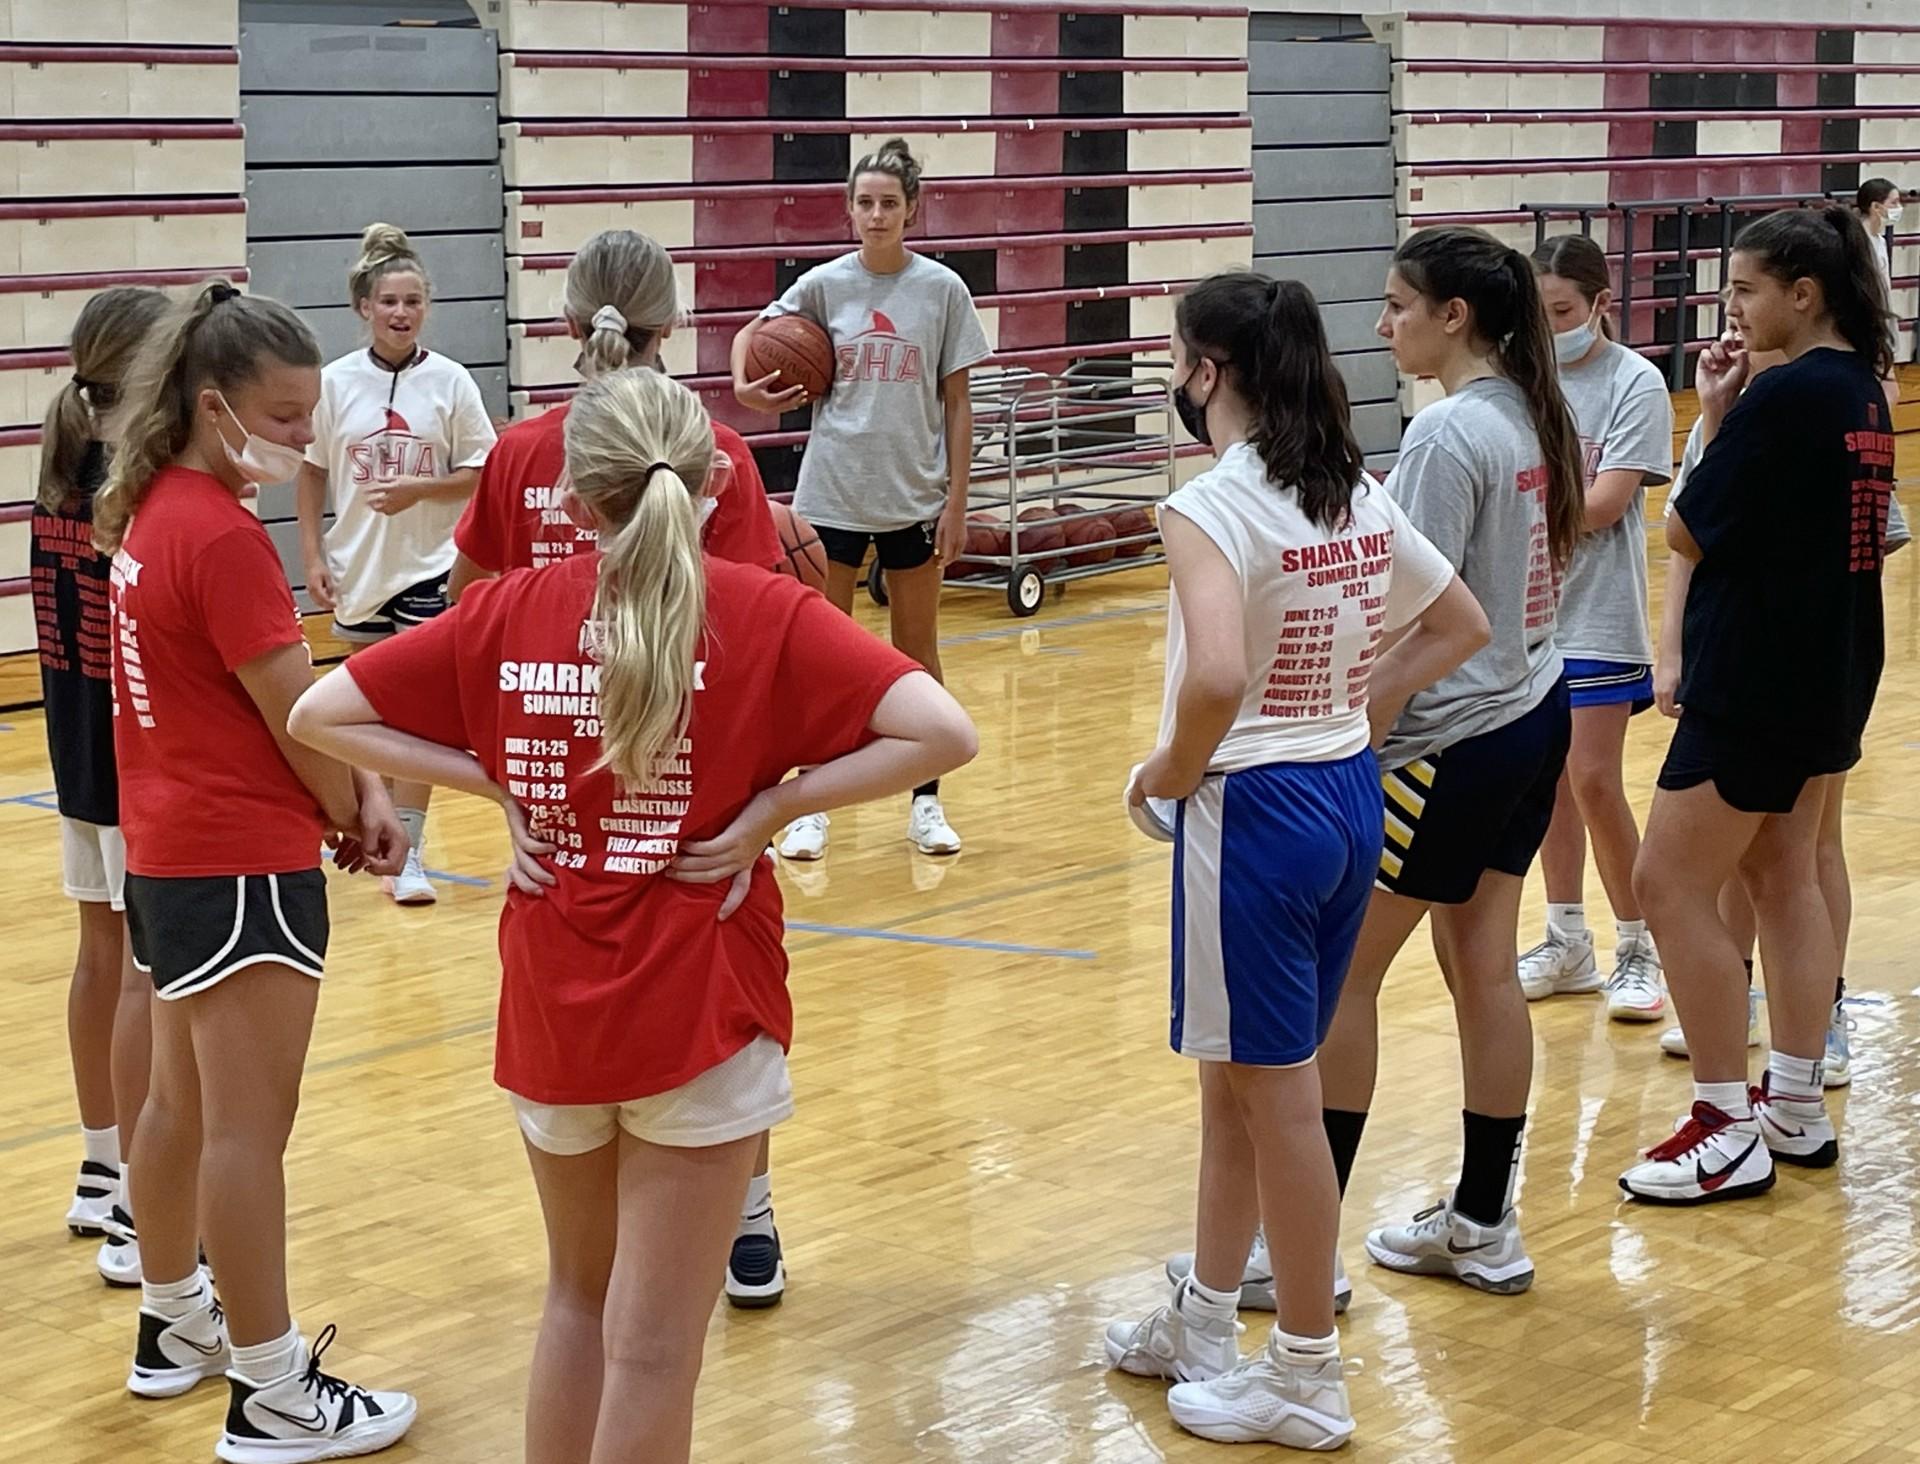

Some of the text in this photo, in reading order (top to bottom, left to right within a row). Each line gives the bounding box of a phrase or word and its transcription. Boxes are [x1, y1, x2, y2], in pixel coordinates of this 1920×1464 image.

[837, 343, 922, 382] SHA
[346, 442, 434, 484] SHA
[1282, 540, 1357, 572] SHARK
[1307, 565, 1357, 587] SUMMER
[1342, 581, 1369, 599] 2021
[1283, 605, 1338, 622] JUNE 21-25
[1280, 627, 1307, 638] JULY
[1277, 643, 1303, 655] JULY
[1272, 658, 1299, 670] JULY
[500, 661, 603, 694] SHARK
[1268, 673, 1314, 685] AUGUST
[1264, 688, 1311, 701] AUGUST
[1260, 704, 1306, 718] AUGUST
[505, 737, 568, 756] JUNE 21-25
[530, 761, 565, 778] 12-16
[530, 782, 567, 800] 19-23
